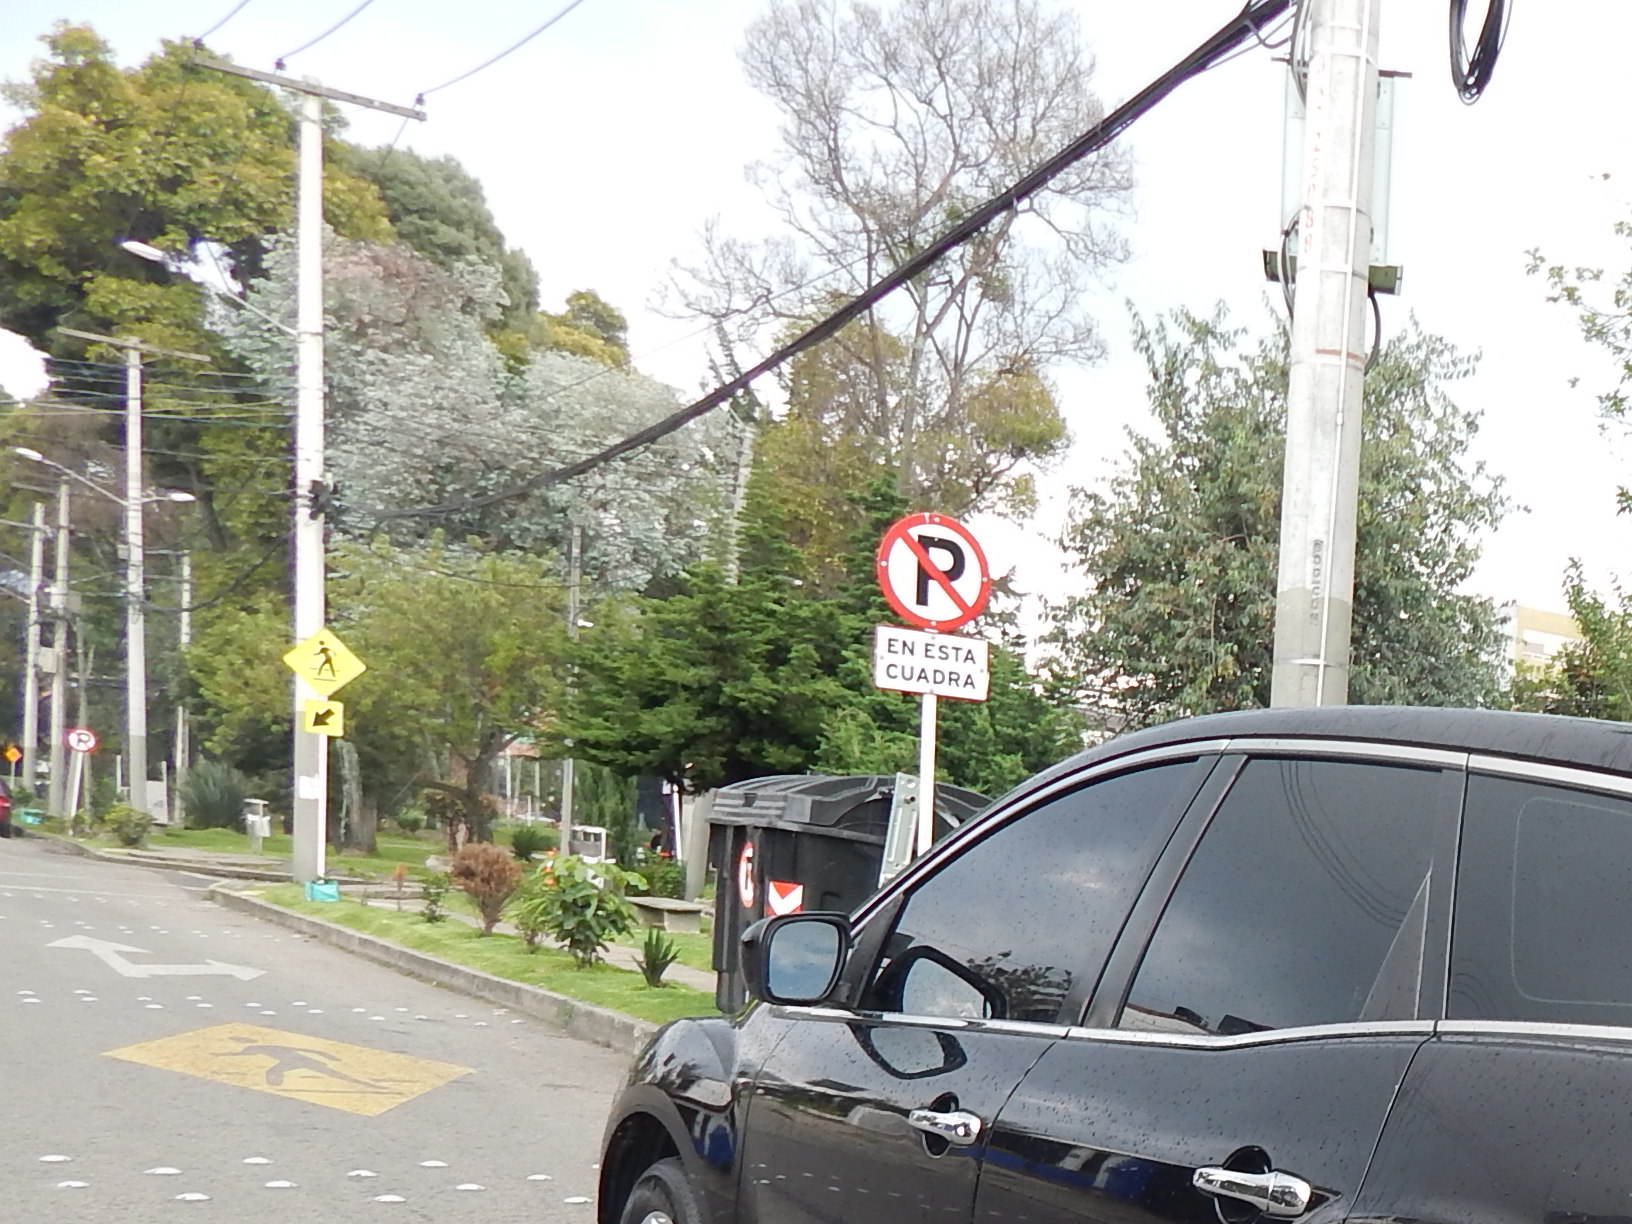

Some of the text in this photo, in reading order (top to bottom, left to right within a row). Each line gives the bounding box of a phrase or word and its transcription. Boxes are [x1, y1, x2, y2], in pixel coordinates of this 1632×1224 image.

[915, 533, 966, 607] P
[887, 638, 976, 665] EN ESTA
[885, 664, 976, 689] CUADRA
